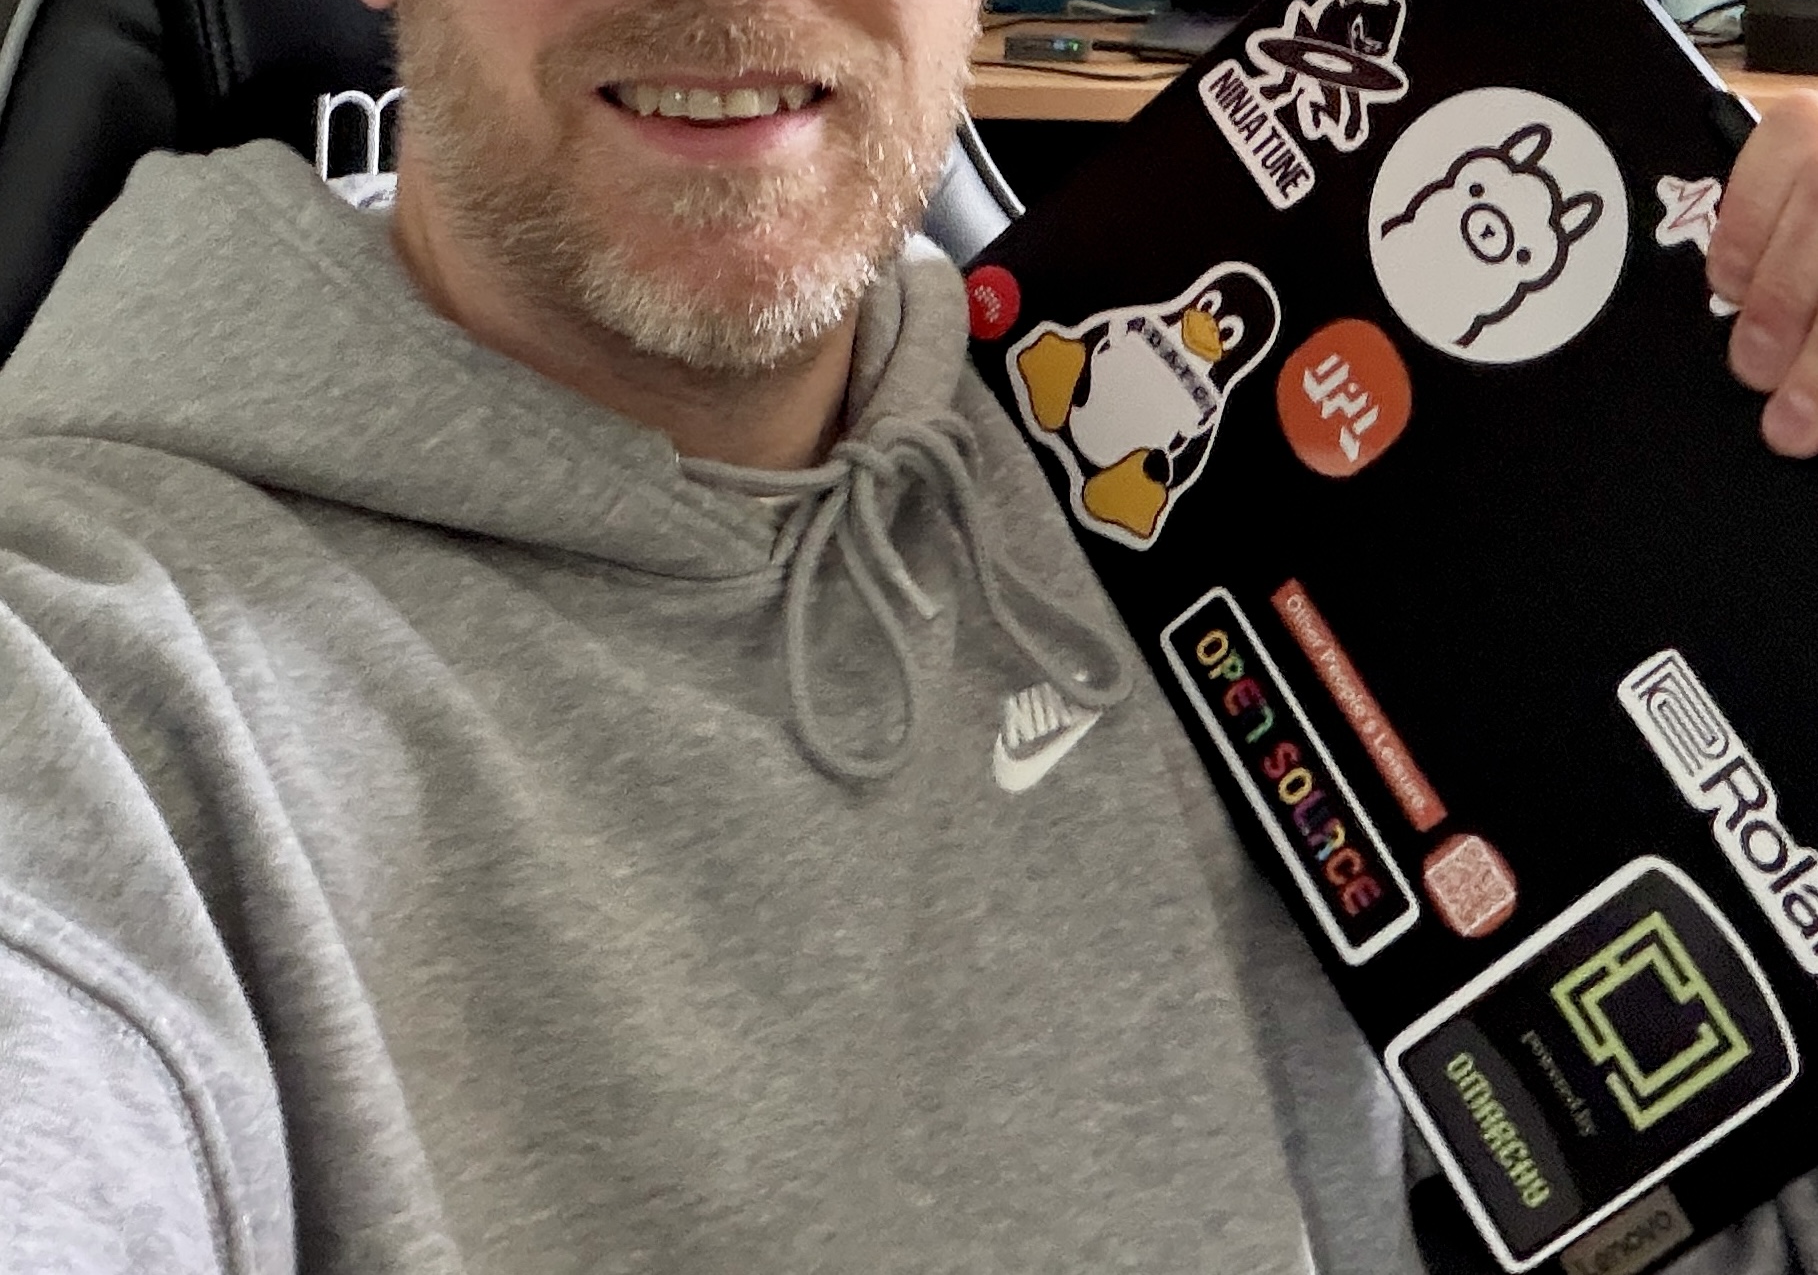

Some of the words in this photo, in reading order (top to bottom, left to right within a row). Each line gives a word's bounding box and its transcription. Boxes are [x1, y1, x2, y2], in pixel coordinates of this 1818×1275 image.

[1209, 67, 1268, 144] NINJA
[1253, 127, 1311, 200] TUNE
[1699, 755, 1818, 956] Rola
